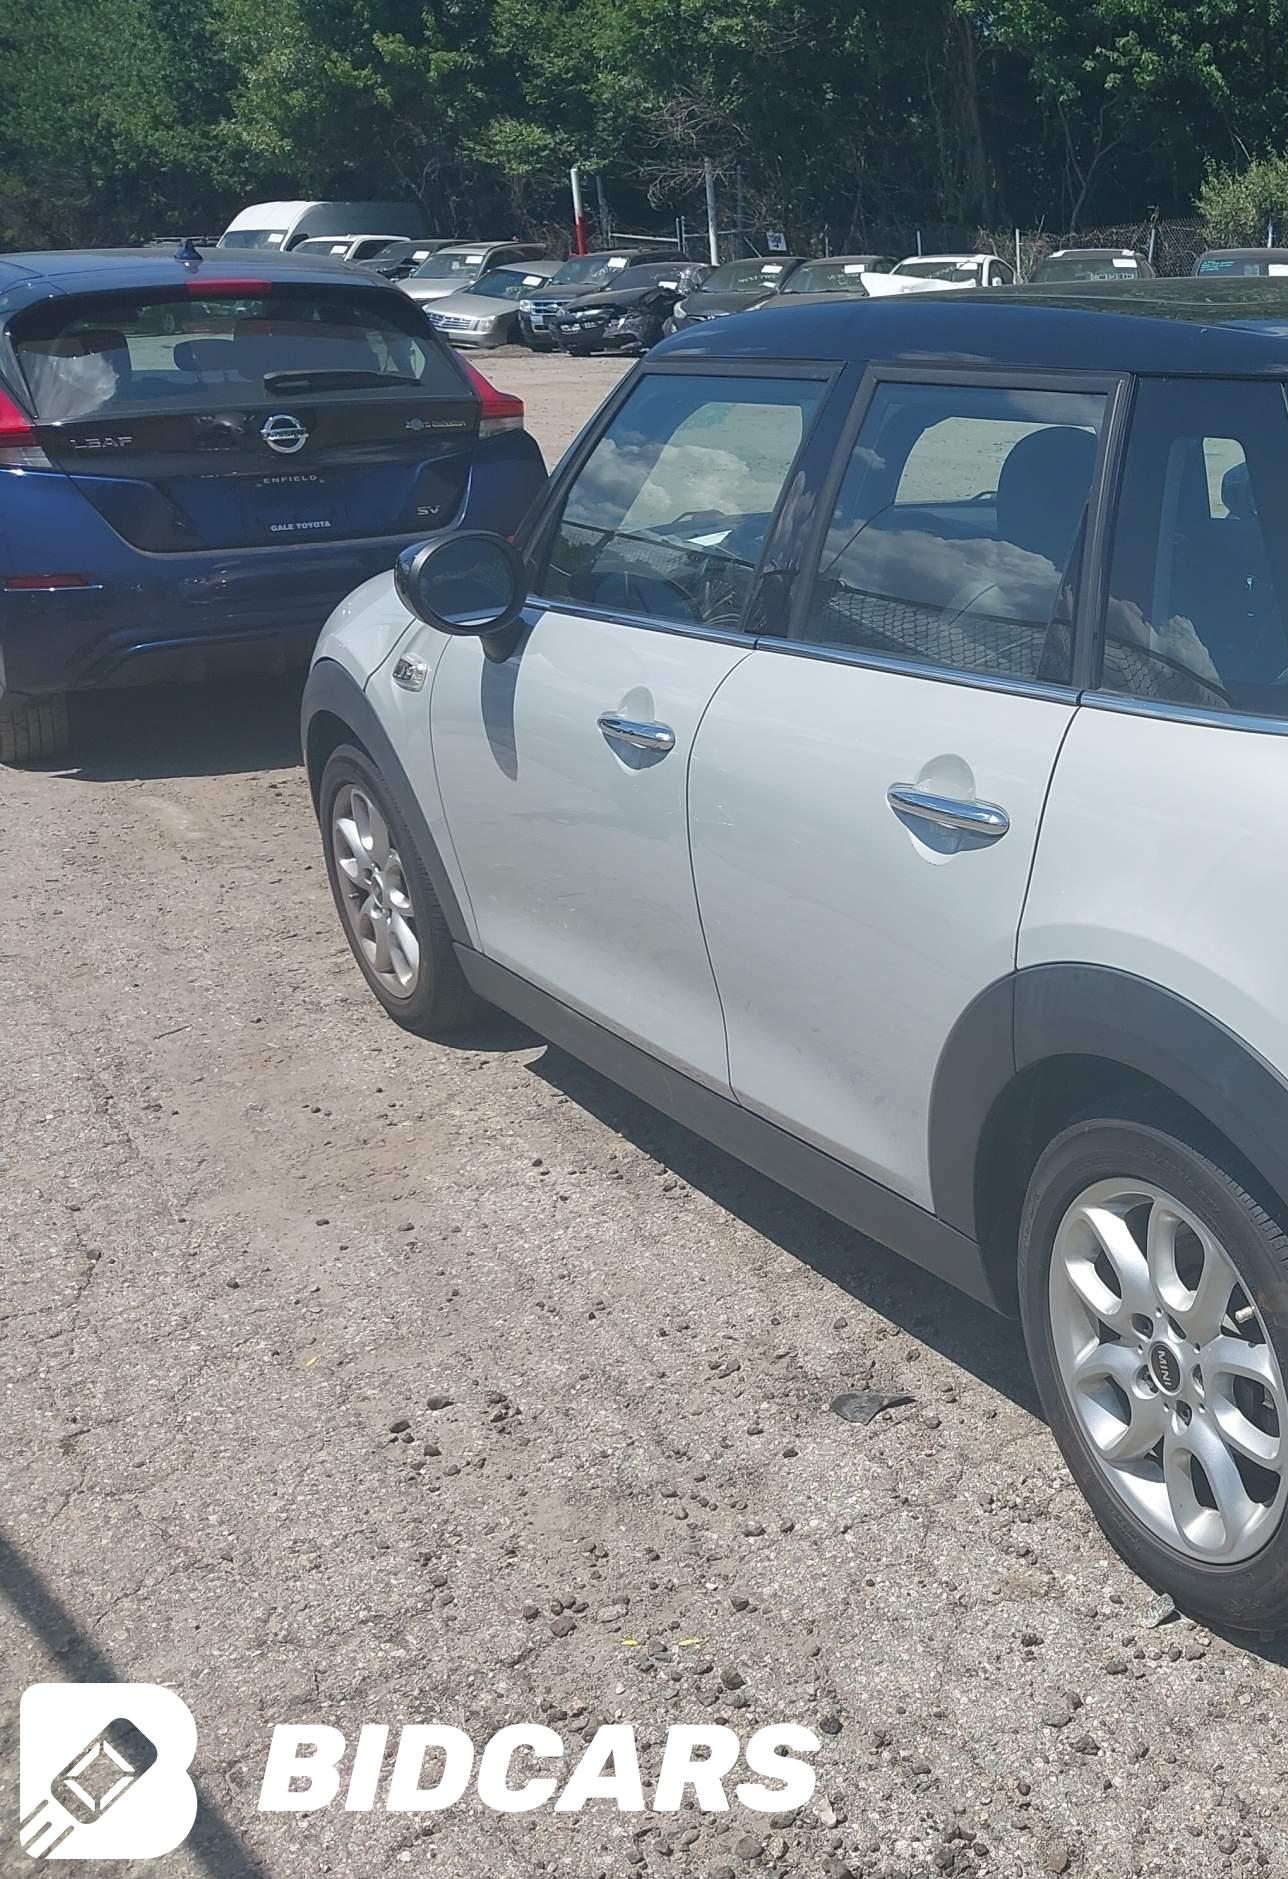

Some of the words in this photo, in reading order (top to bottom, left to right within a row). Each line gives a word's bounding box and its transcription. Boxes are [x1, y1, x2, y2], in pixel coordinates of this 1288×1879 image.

[70, 436, 133, 449] LEAF
[263, 474, 317, 483] ENFIELD
[417, 504, 441, 515] SV
[270, 523, 294, 531] GALE
[296, 521, 331, 529] TOYOTA
[1157, 1350, 1172, 1386] MINI
